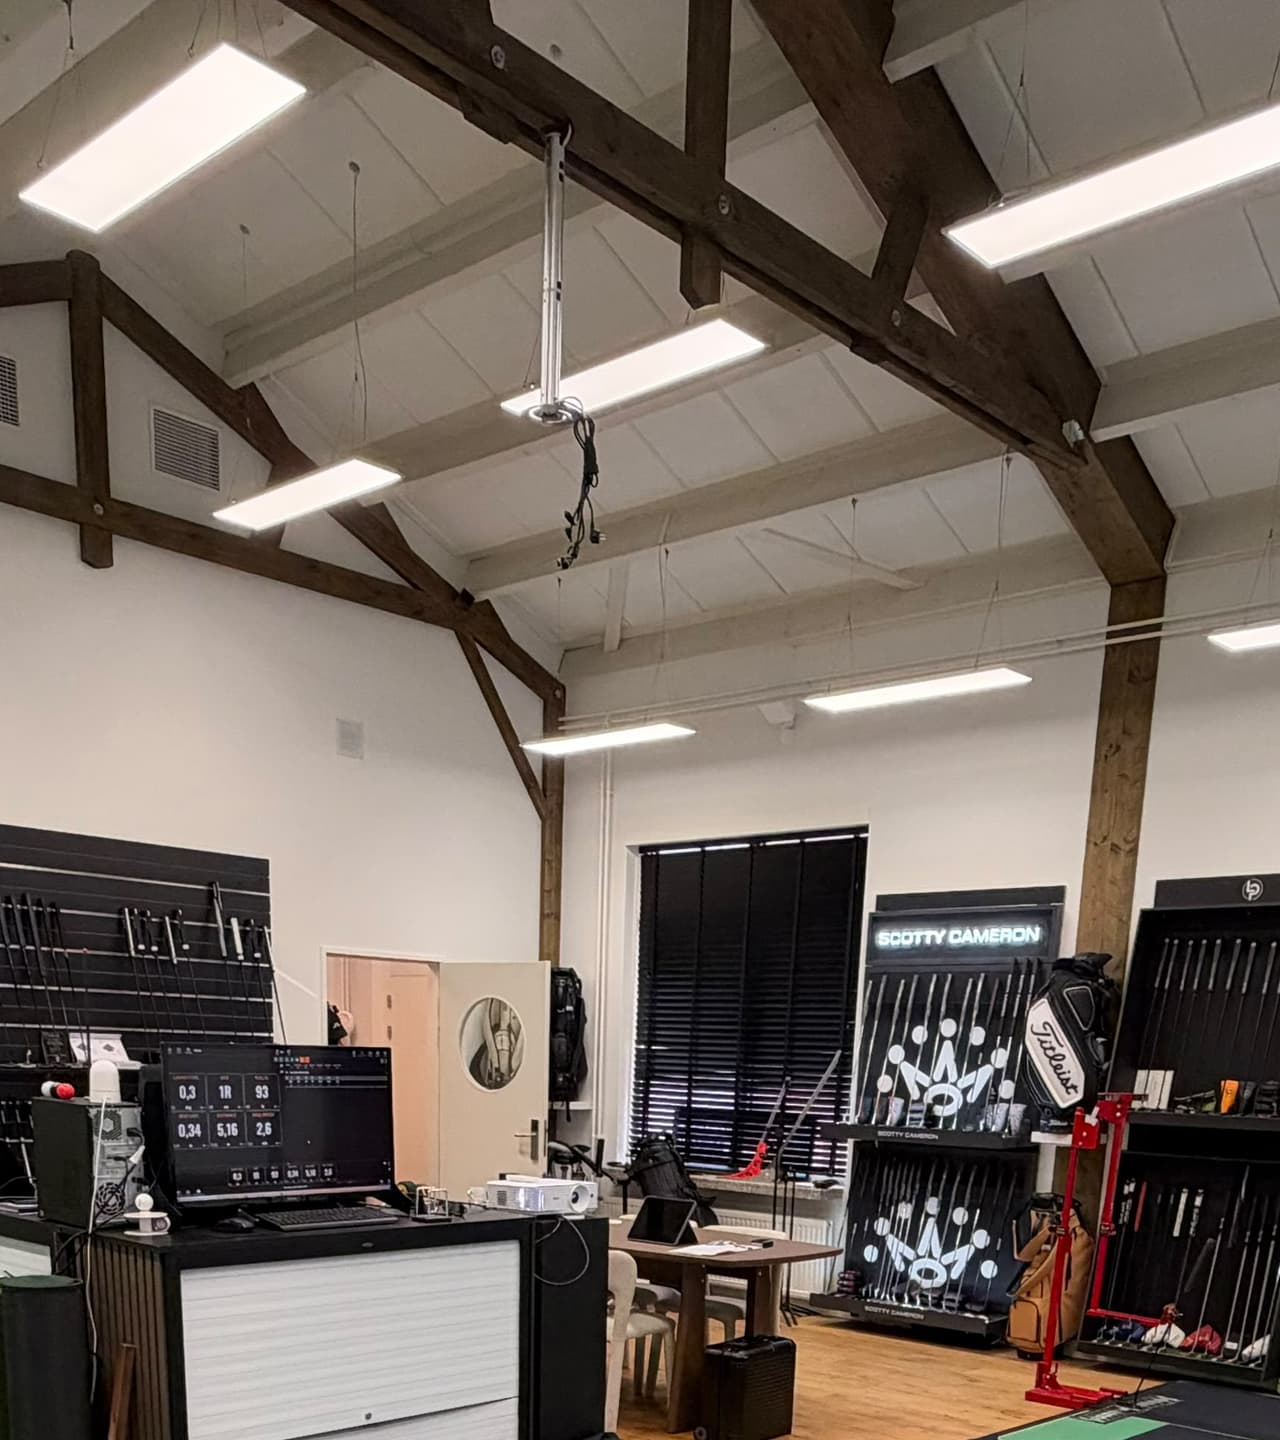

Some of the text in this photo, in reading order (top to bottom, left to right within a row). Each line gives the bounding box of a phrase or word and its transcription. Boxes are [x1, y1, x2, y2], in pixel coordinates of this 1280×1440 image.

[877, 925, 1041, 946] SCOTTY CAMERON
[1030, 1021, 1079, 1095] Titleist
[178, 1084, 196, 1100] 0,3
[218, 1084, 232, 1099] 1R
[255, 1084, 269, 1099] 93
[178, 1123, 201, 1139] 0,34
[216, 1122, 238, 1138] 5,16
[256, 1121, 272, 1136] 2,6
